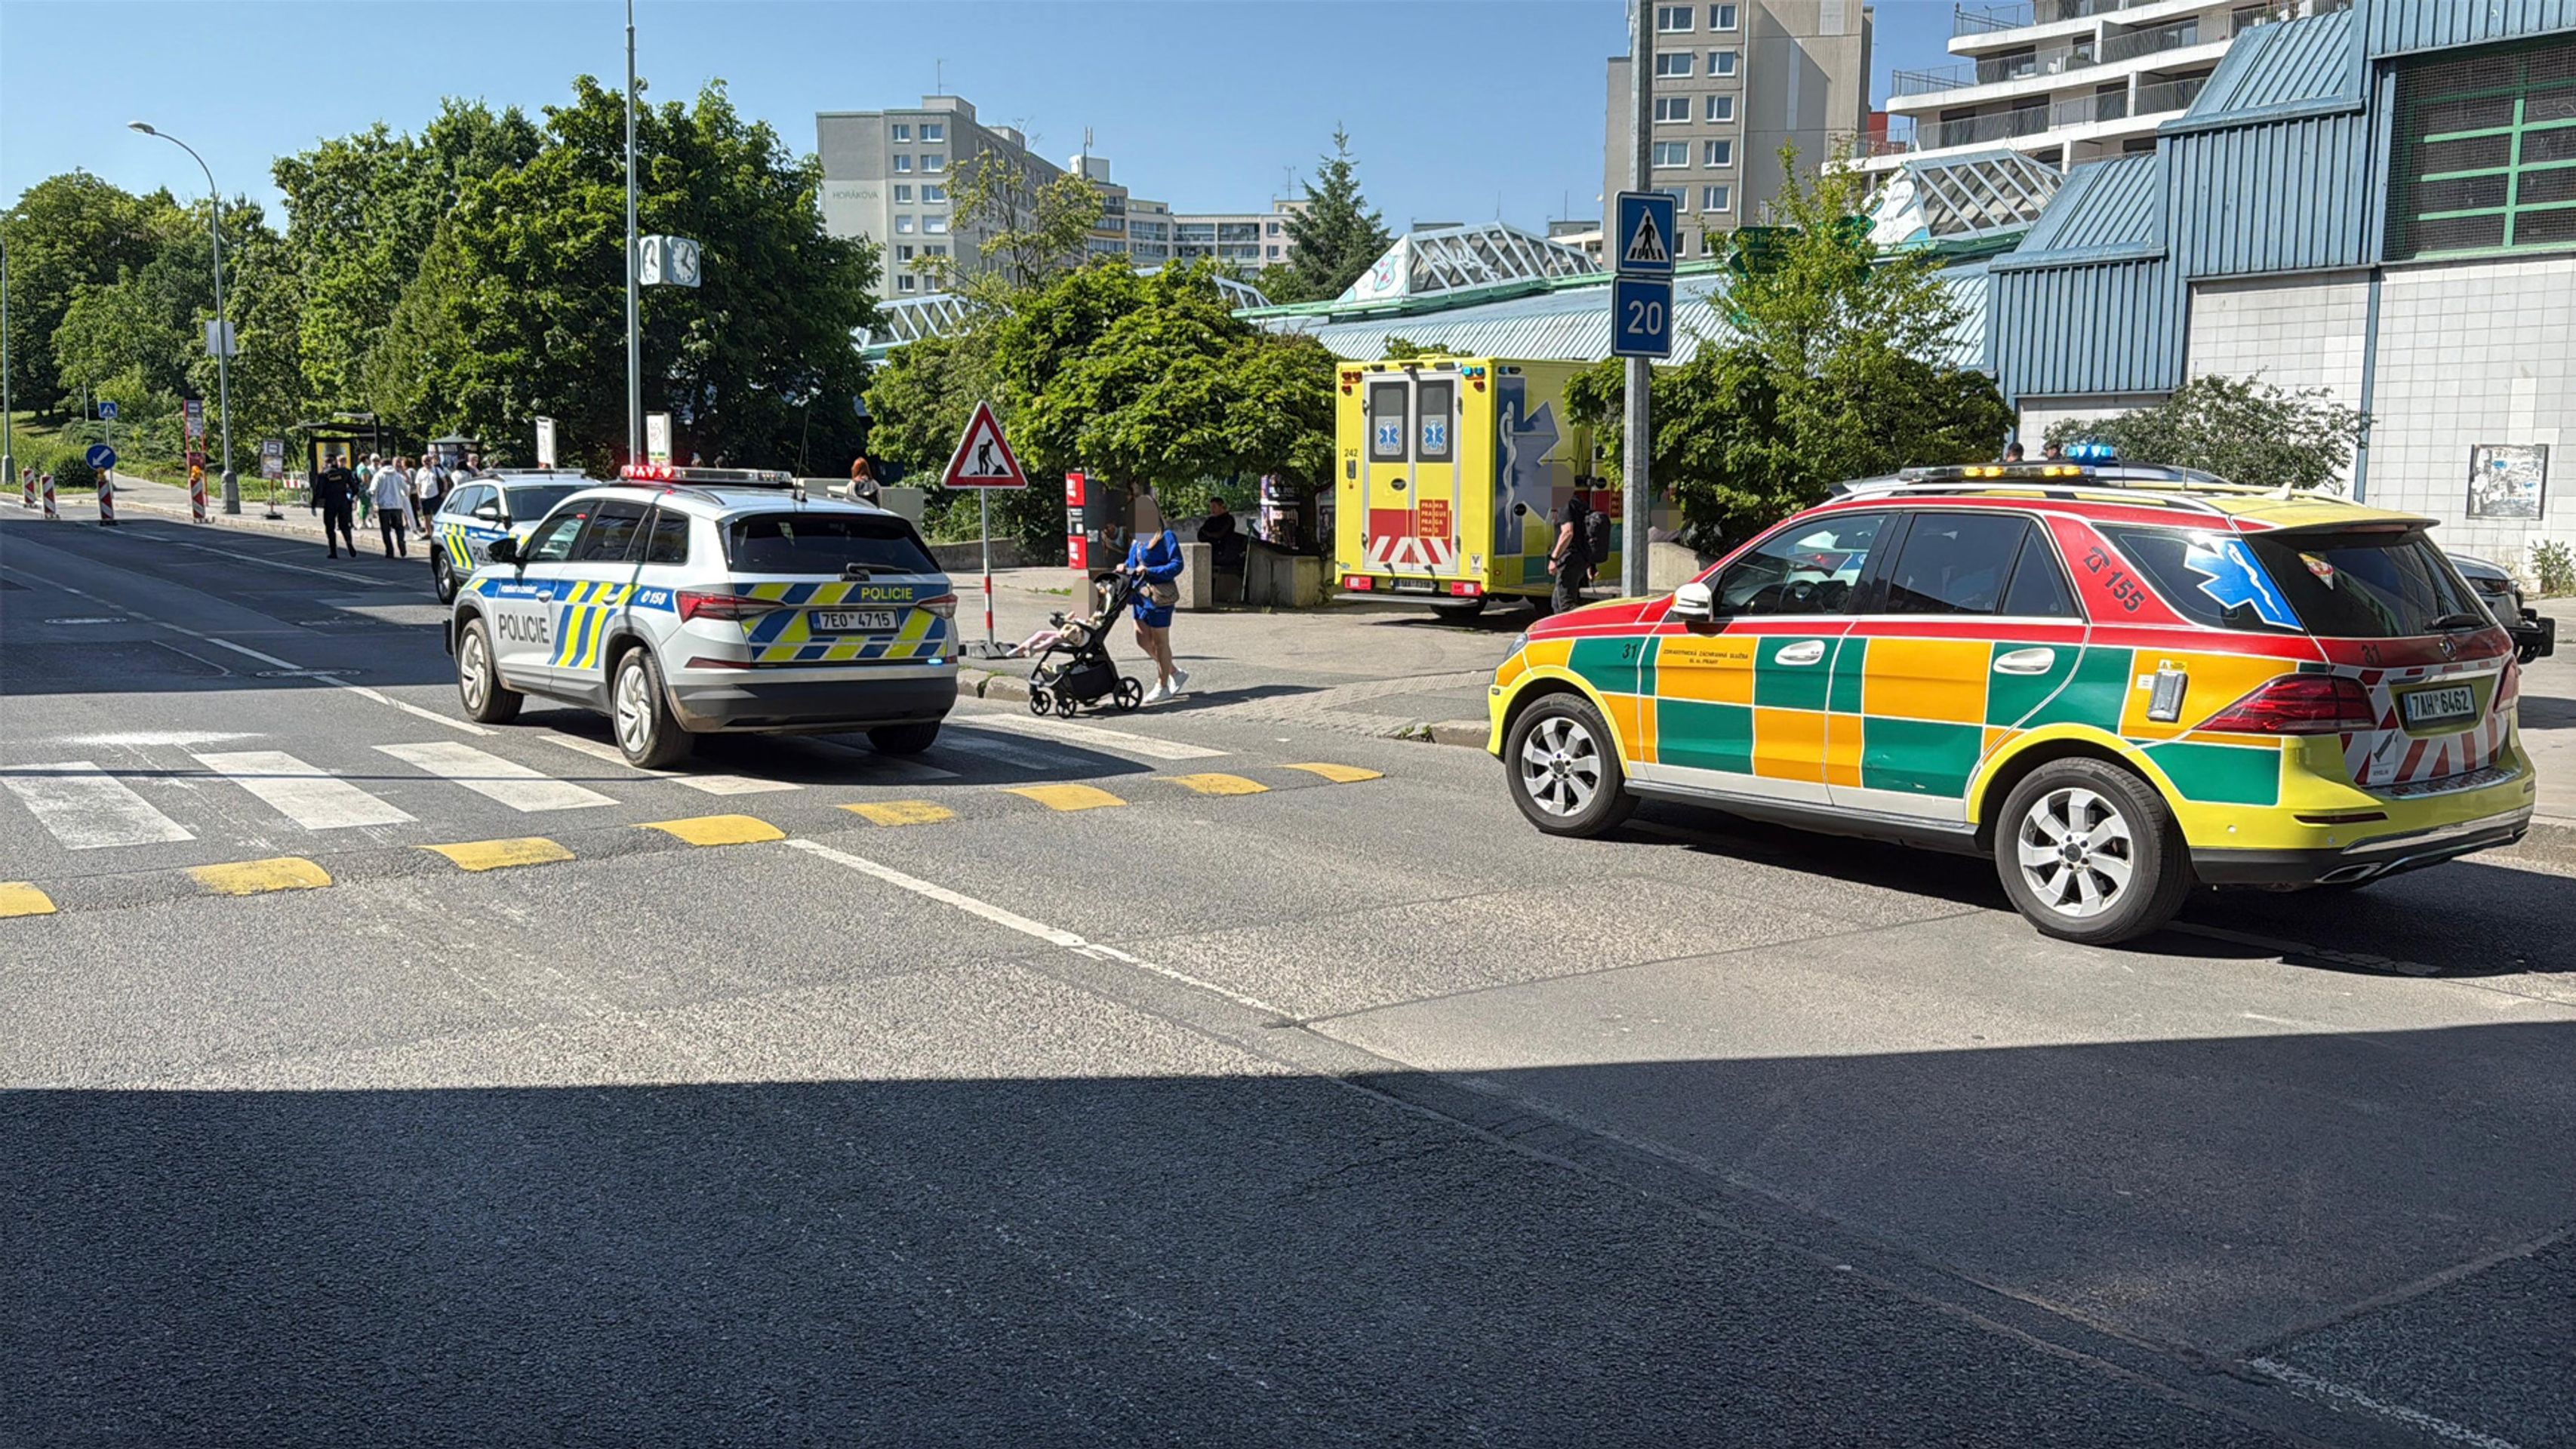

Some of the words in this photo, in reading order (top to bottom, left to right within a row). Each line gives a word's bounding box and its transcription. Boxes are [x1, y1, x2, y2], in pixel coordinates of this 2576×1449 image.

[1627, 300, 1662, 335] 20
[1344, 448, 1358, 457] 242
[472, 546, 493, 563] POLI
[649, 592, 667, 605] 158
[861, 587, 913, 600] POLICIE
[2105, 571, 2145, 611] 155
[858, 613, 890, 627] 4715
[498, 614, 549, 644] POLICIE
[1622, 643, 1637, 659] 31
[2362, 644, 2383, 665] 31
[2412, 694, 2434, 717] 7AH
[2440, 690, 2469, 713] 6462
